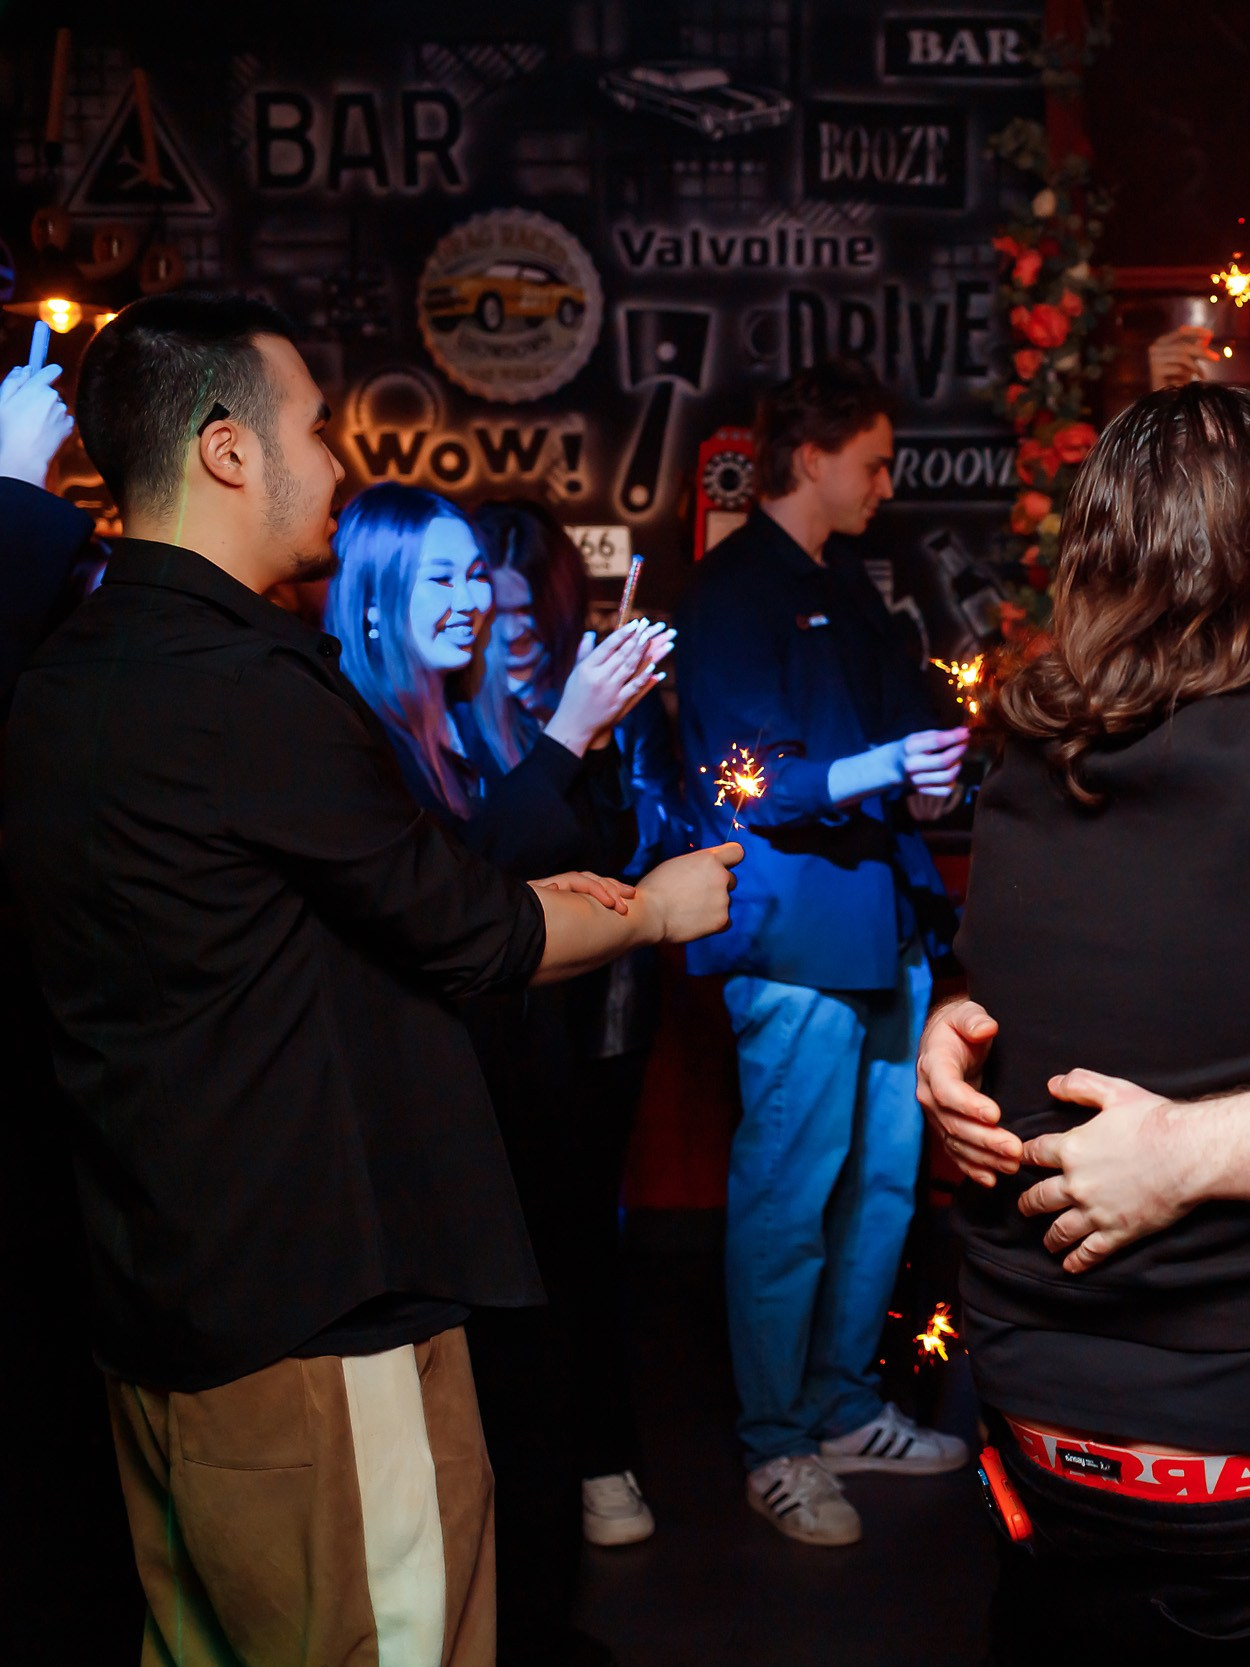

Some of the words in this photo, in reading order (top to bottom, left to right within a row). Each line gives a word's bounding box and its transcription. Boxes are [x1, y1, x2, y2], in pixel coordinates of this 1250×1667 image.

[906, 28, 1022, 66] BAR
[255, 92, 462, 190] BAR
[818, 120, 950, 187] BOOZE
[618, 228, 875, 268] Valvoline
